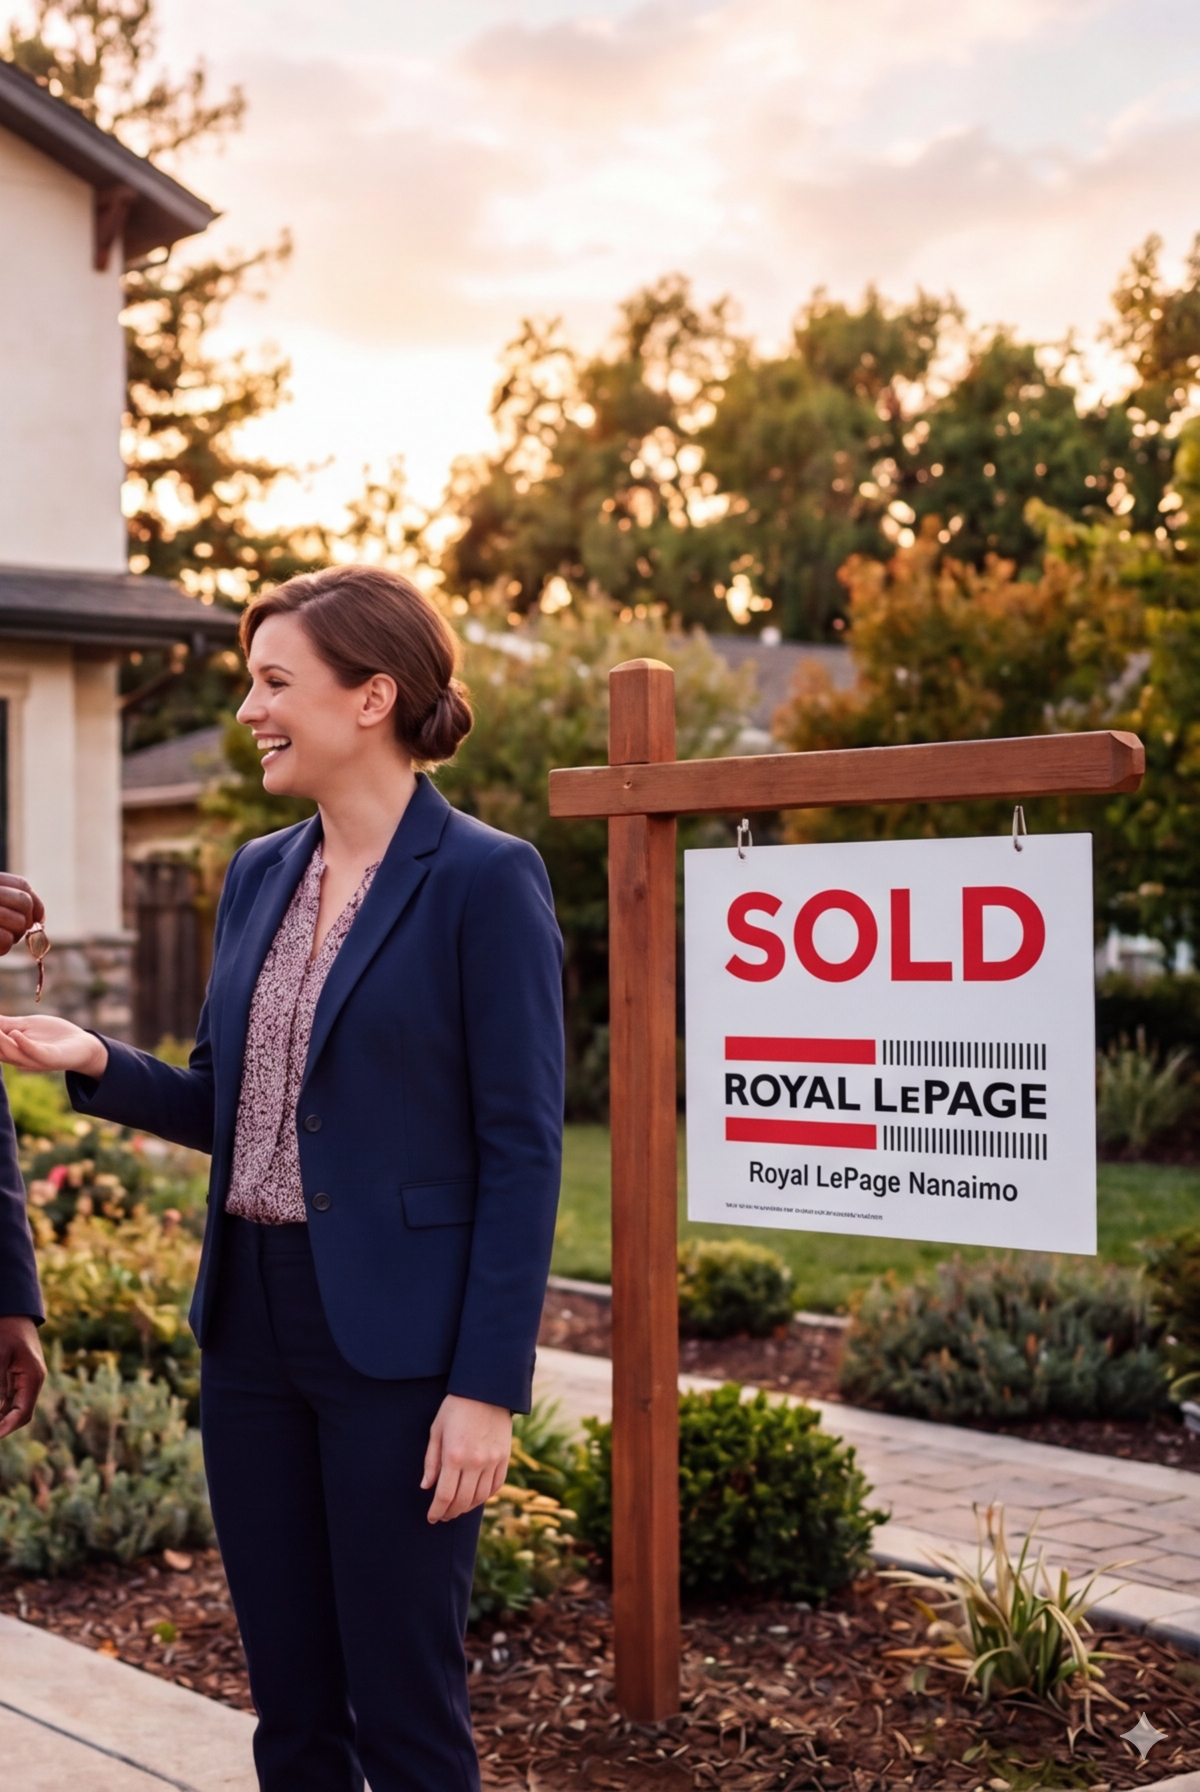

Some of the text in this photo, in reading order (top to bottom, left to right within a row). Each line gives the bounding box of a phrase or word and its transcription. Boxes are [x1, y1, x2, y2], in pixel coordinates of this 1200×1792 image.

[724, 885, 1046, 983] SOLD
[724, 1072, 861, 1112] ROYAL
[749, 1160, 1019, 1202] Royal LePage Nanaimo
